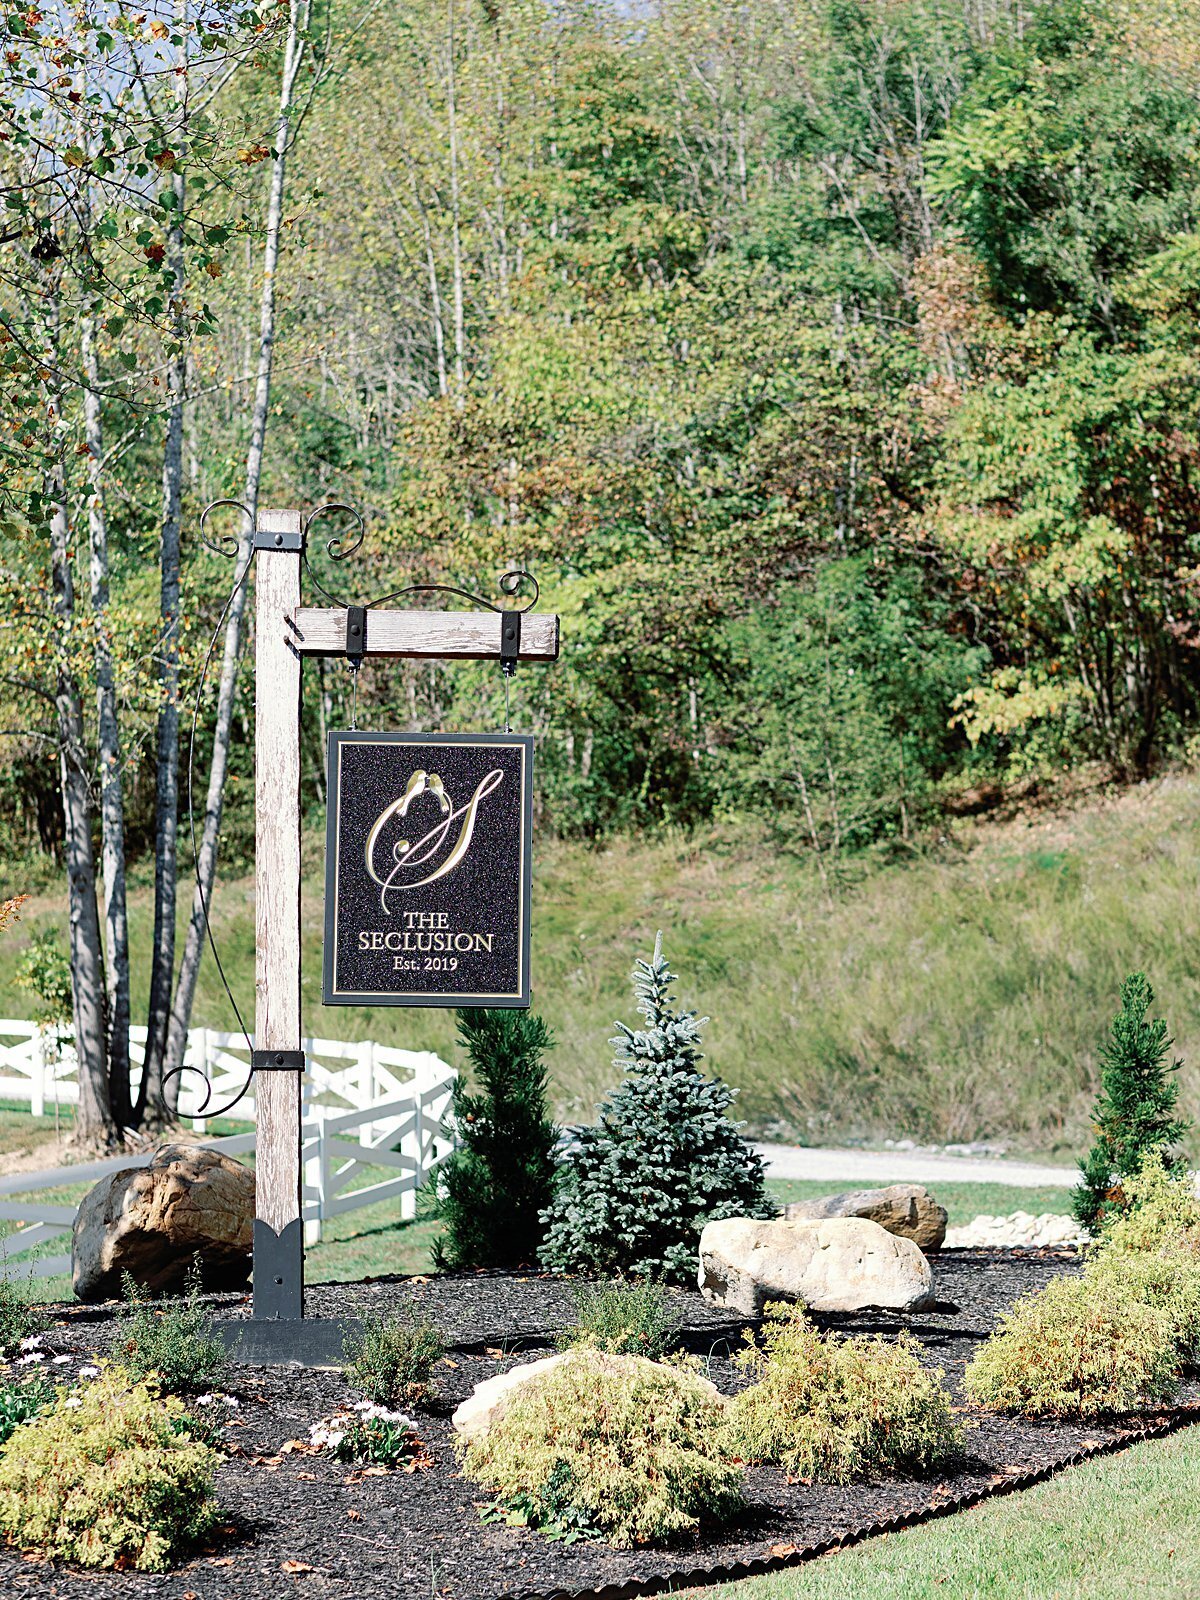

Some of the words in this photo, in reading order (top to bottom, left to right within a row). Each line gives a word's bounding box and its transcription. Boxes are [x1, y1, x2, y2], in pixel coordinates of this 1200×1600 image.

[403, 911, 449, 929] THE
[358, 931, 495, 952] SECLUSION
[393, 956, 420, 970] Est.
[424, 957, 458, 971] 2019
